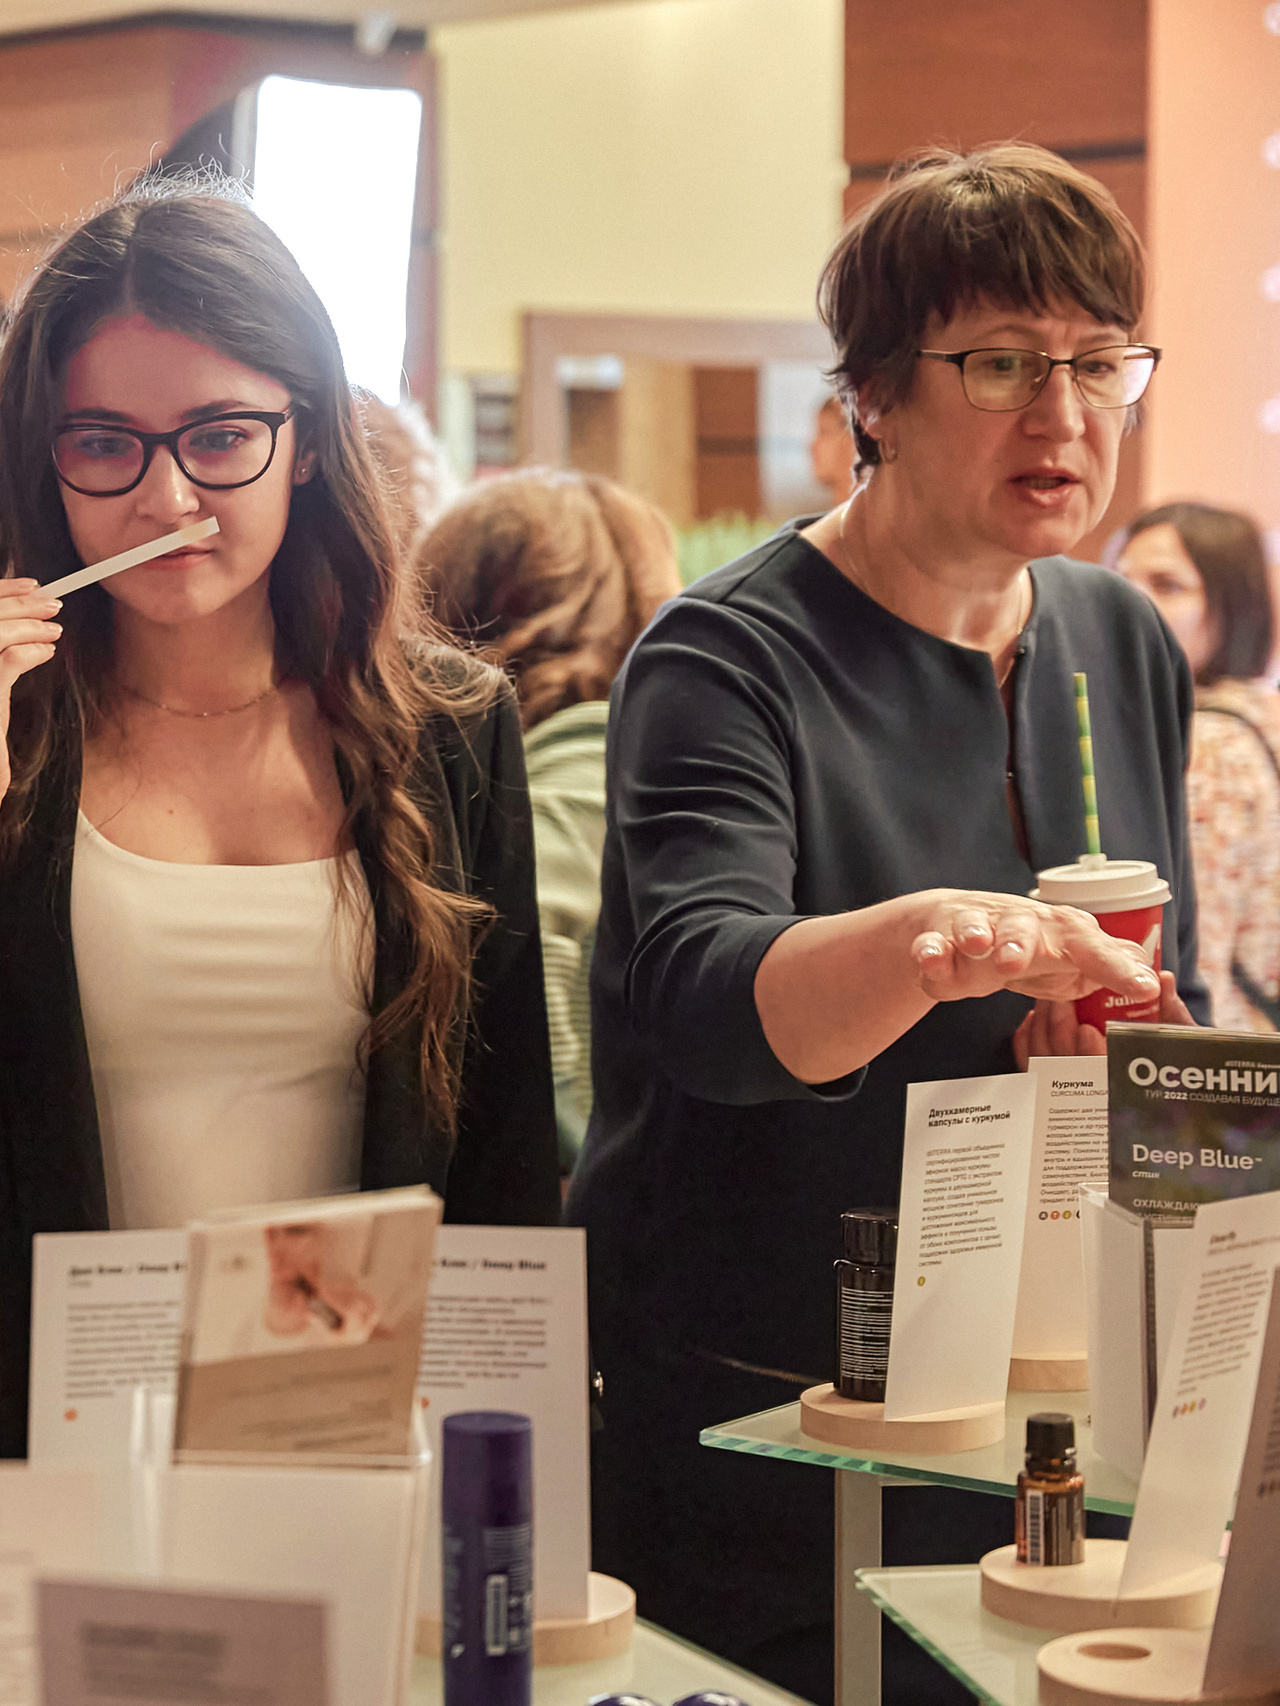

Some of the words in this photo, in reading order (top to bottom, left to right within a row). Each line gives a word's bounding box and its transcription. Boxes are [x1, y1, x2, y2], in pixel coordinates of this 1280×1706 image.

[1128, 1057, 1280, 1095] Осенни
[1052, 1080, 1094, 1090] Куркума
[1164, 1090, 1188, 1100] 2022
[928, 1104, 992, 1119] Двухкамерные
[928, 1117, 964, 1128] капсулы
[971, 1110, 1011, 1124] куркумой
[1132, 1144, 1194, 1170] Deep
